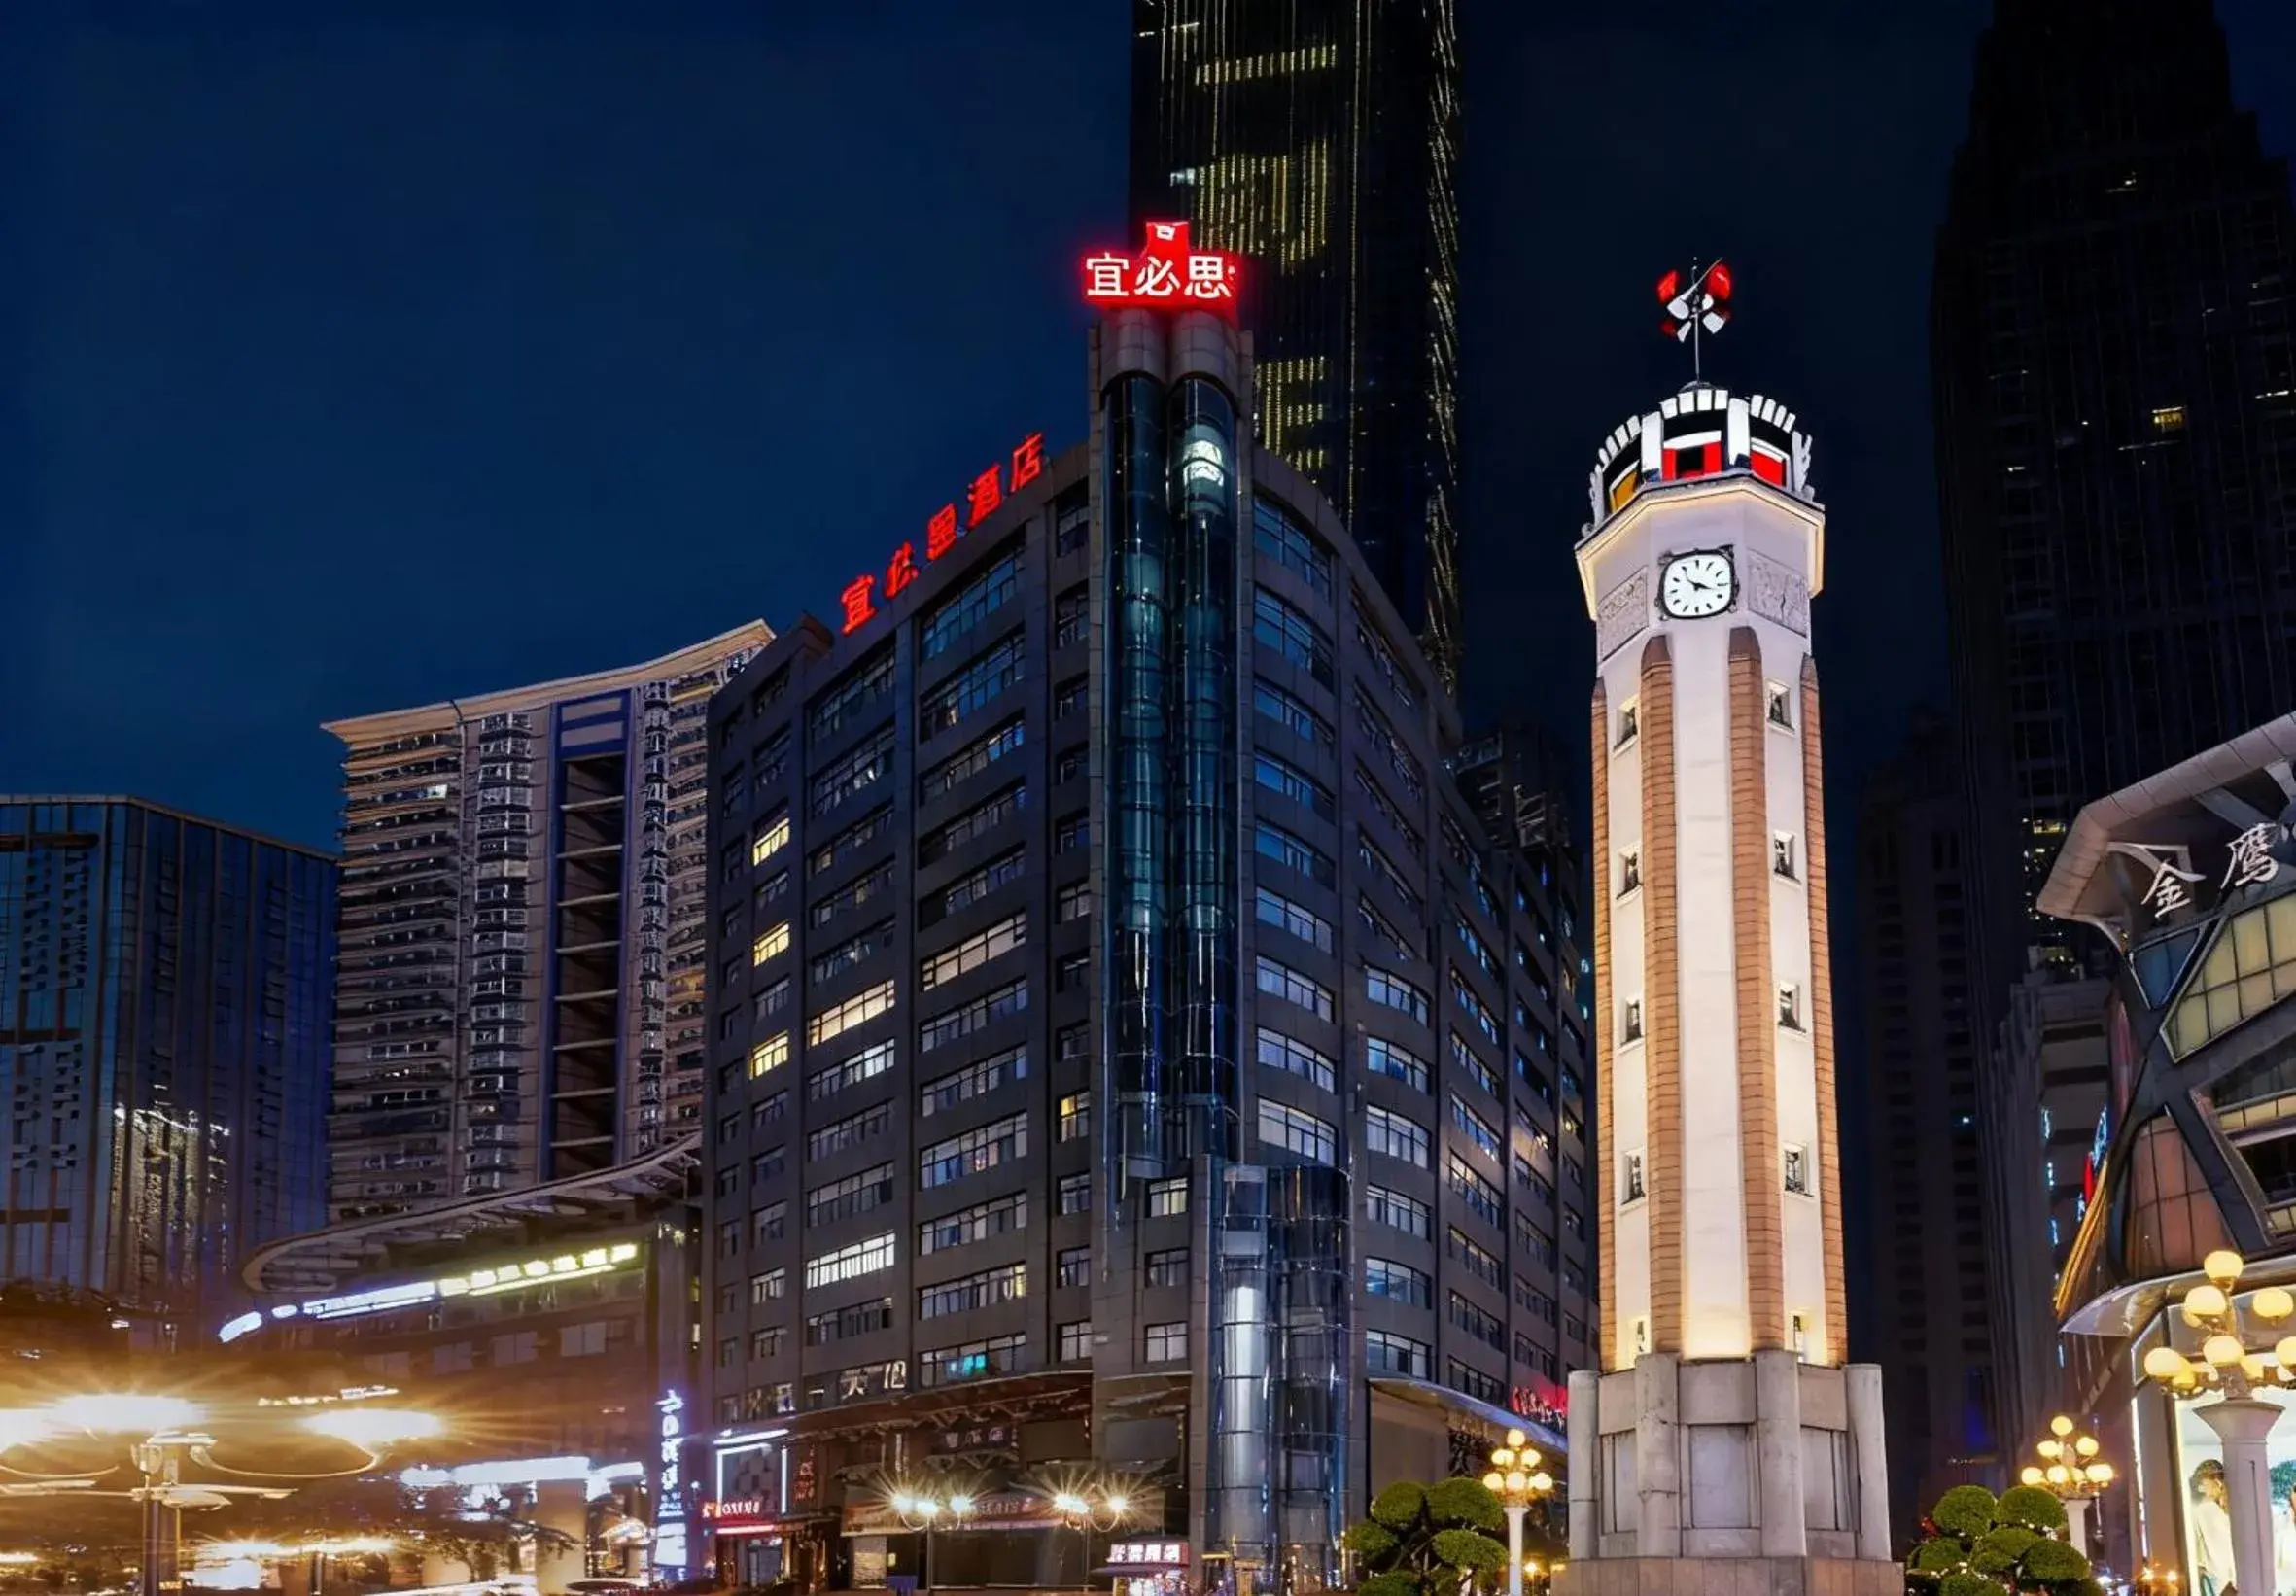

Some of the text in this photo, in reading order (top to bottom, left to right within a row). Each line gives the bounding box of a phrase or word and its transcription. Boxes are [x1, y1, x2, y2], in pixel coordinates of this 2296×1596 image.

[1086, 252, 1232, 298] 宜必思
[2140, 822, 2279, 918] 金鹰
